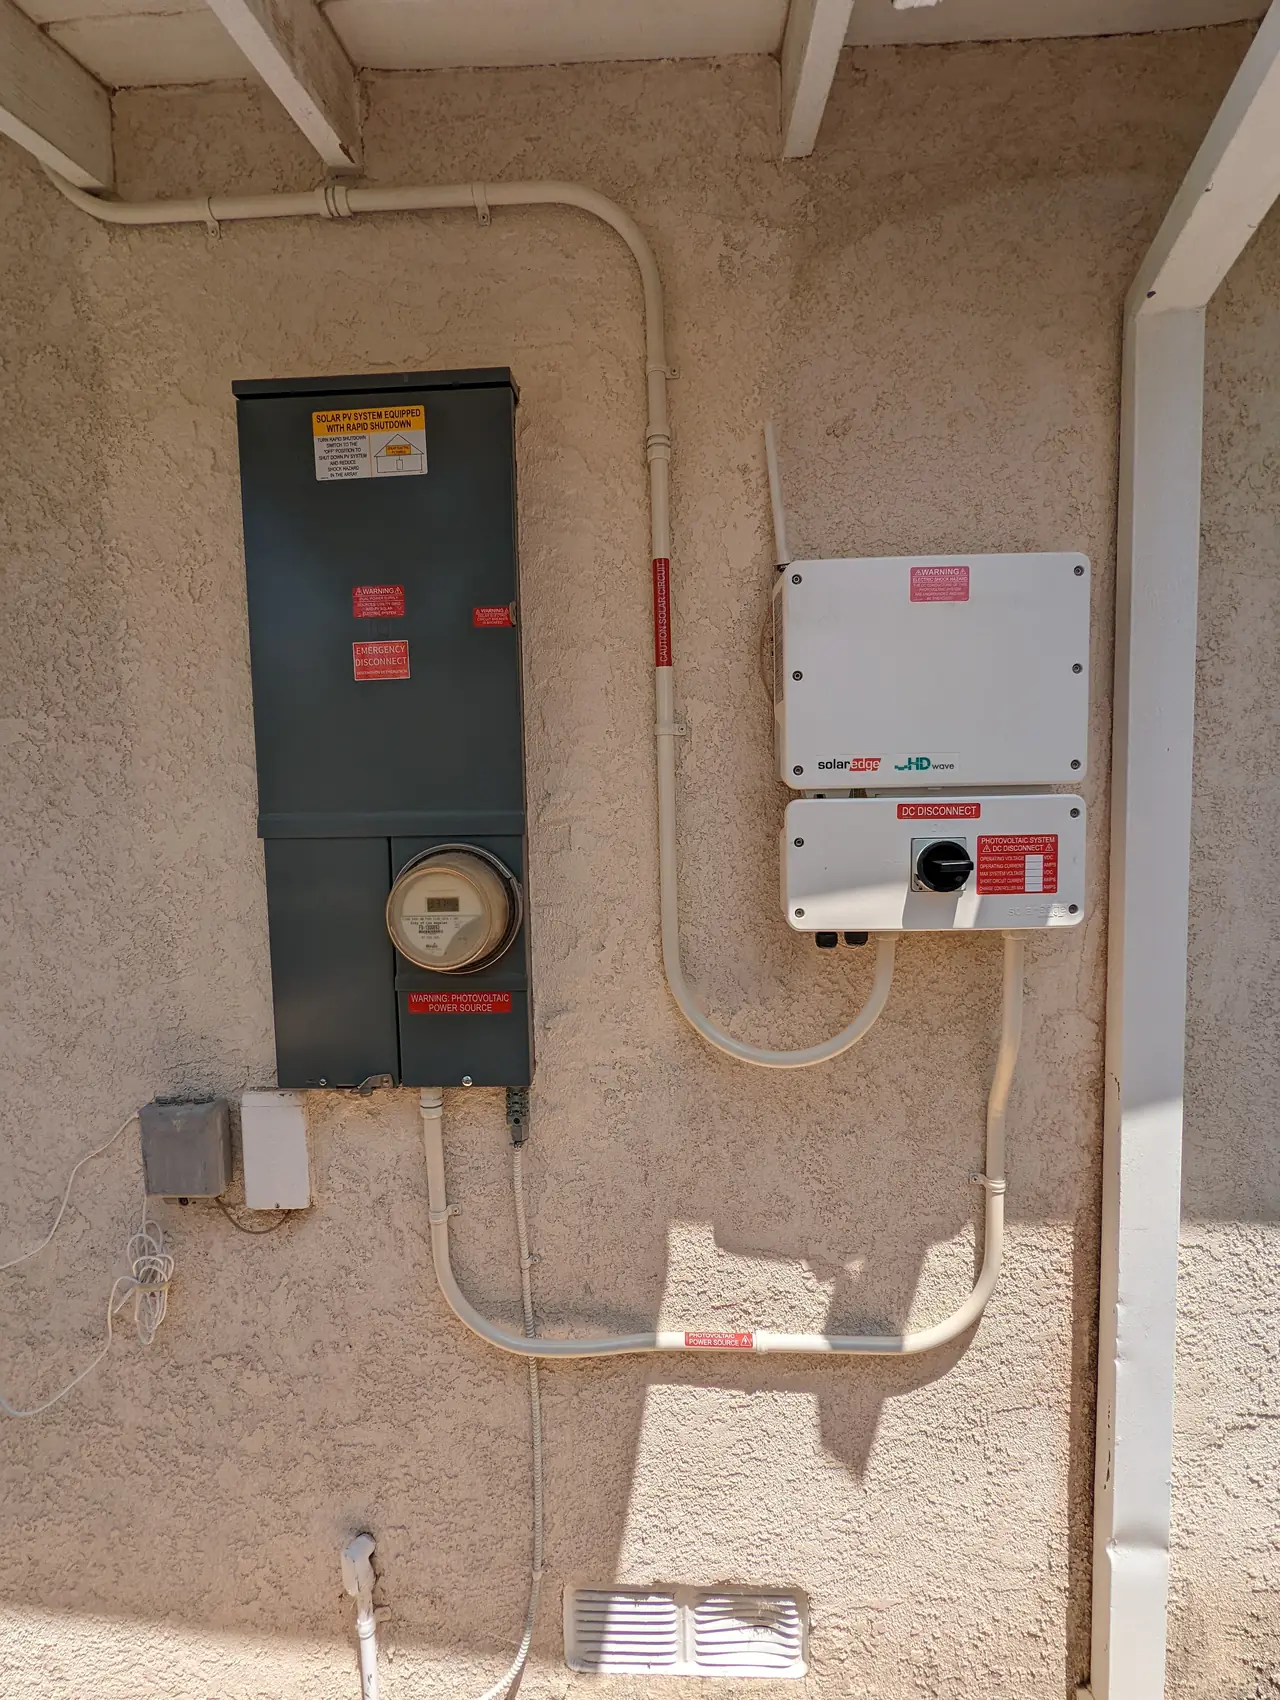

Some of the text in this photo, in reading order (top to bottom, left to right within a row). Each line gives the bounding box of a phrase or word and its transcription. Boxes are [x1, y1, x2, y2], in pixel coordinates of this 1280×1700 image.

[316, 414, 340, 423] SOLAR
[354, 411, 383, 420] SYSTEM
[384, 409, 421, 419] EQUIPPED
[327, 420, 412, 432] WITH RAPID SHUTDOWN
[657, 563, 668, 662] CAUTION SOLAR CIRCUIT
[356, 646, 405, 655] EMERGENCY
[356, 657, 407, 666] DISCONNECT
[818, 758, 881, 771] solaredge
[908, 757, 931, 770] HD
[902, 806, 976, 816] DC DISCONNECT
[452, 994, 509, 1002] PHOTOVOLTAIC
